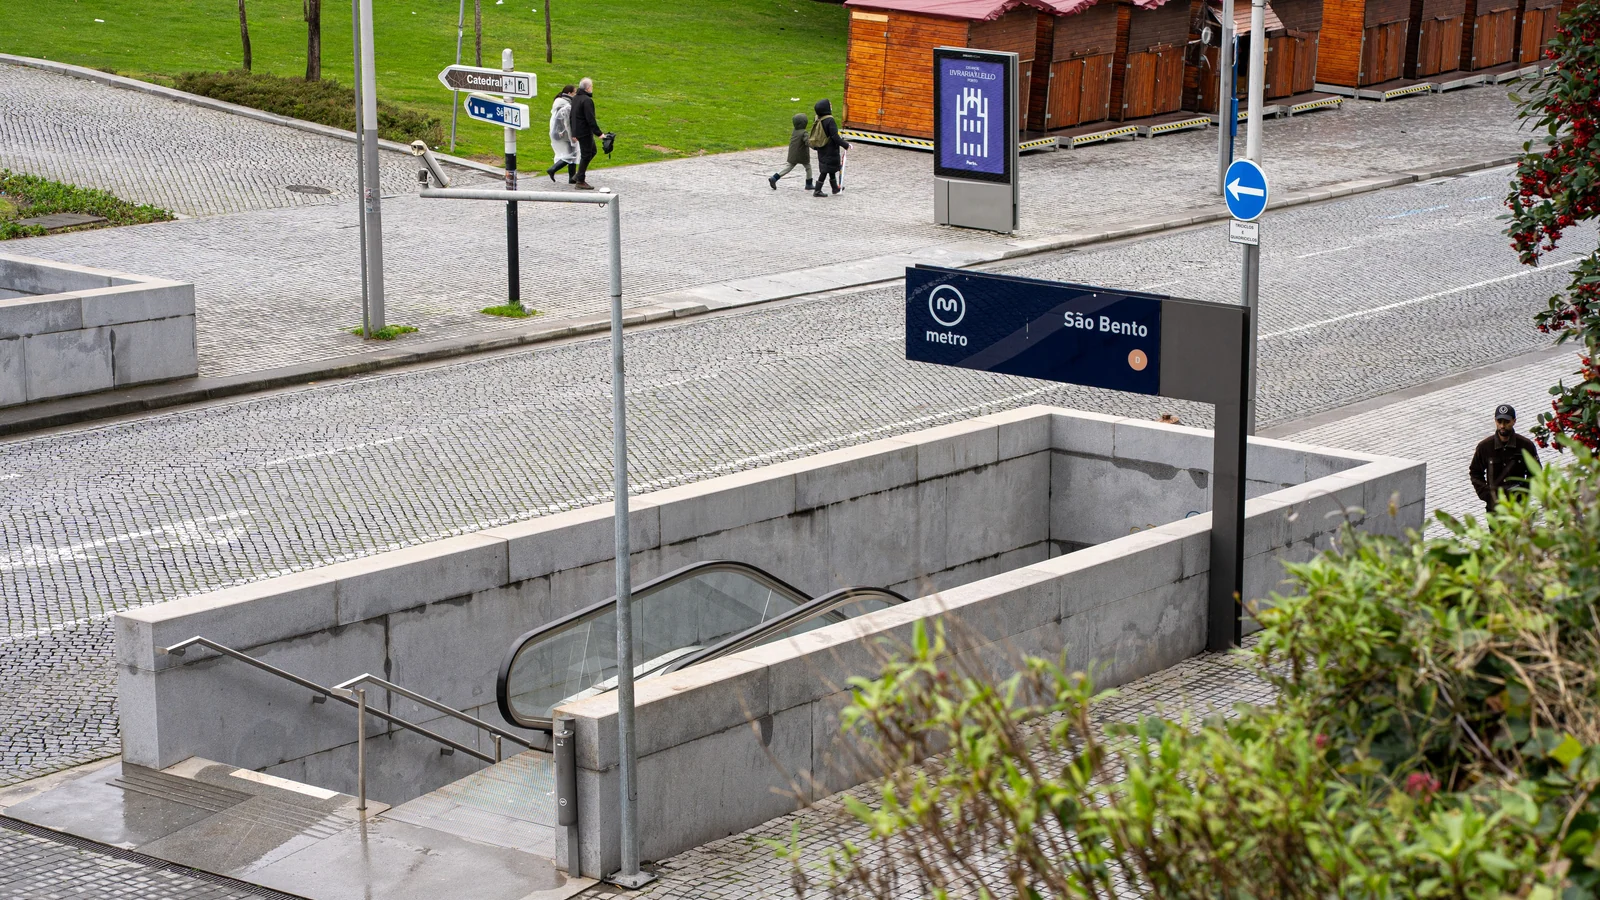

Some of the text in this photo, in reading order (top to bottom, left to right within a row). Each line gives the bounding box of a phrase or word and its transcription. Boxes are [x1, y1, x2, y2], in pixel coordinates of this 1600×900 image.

[466, 74, 502, 87] Catedral
[1064, 311, 1148, 337] São Bento
[926, 330, 968, 346] metro
[1135, 356, 1141, 364] D
